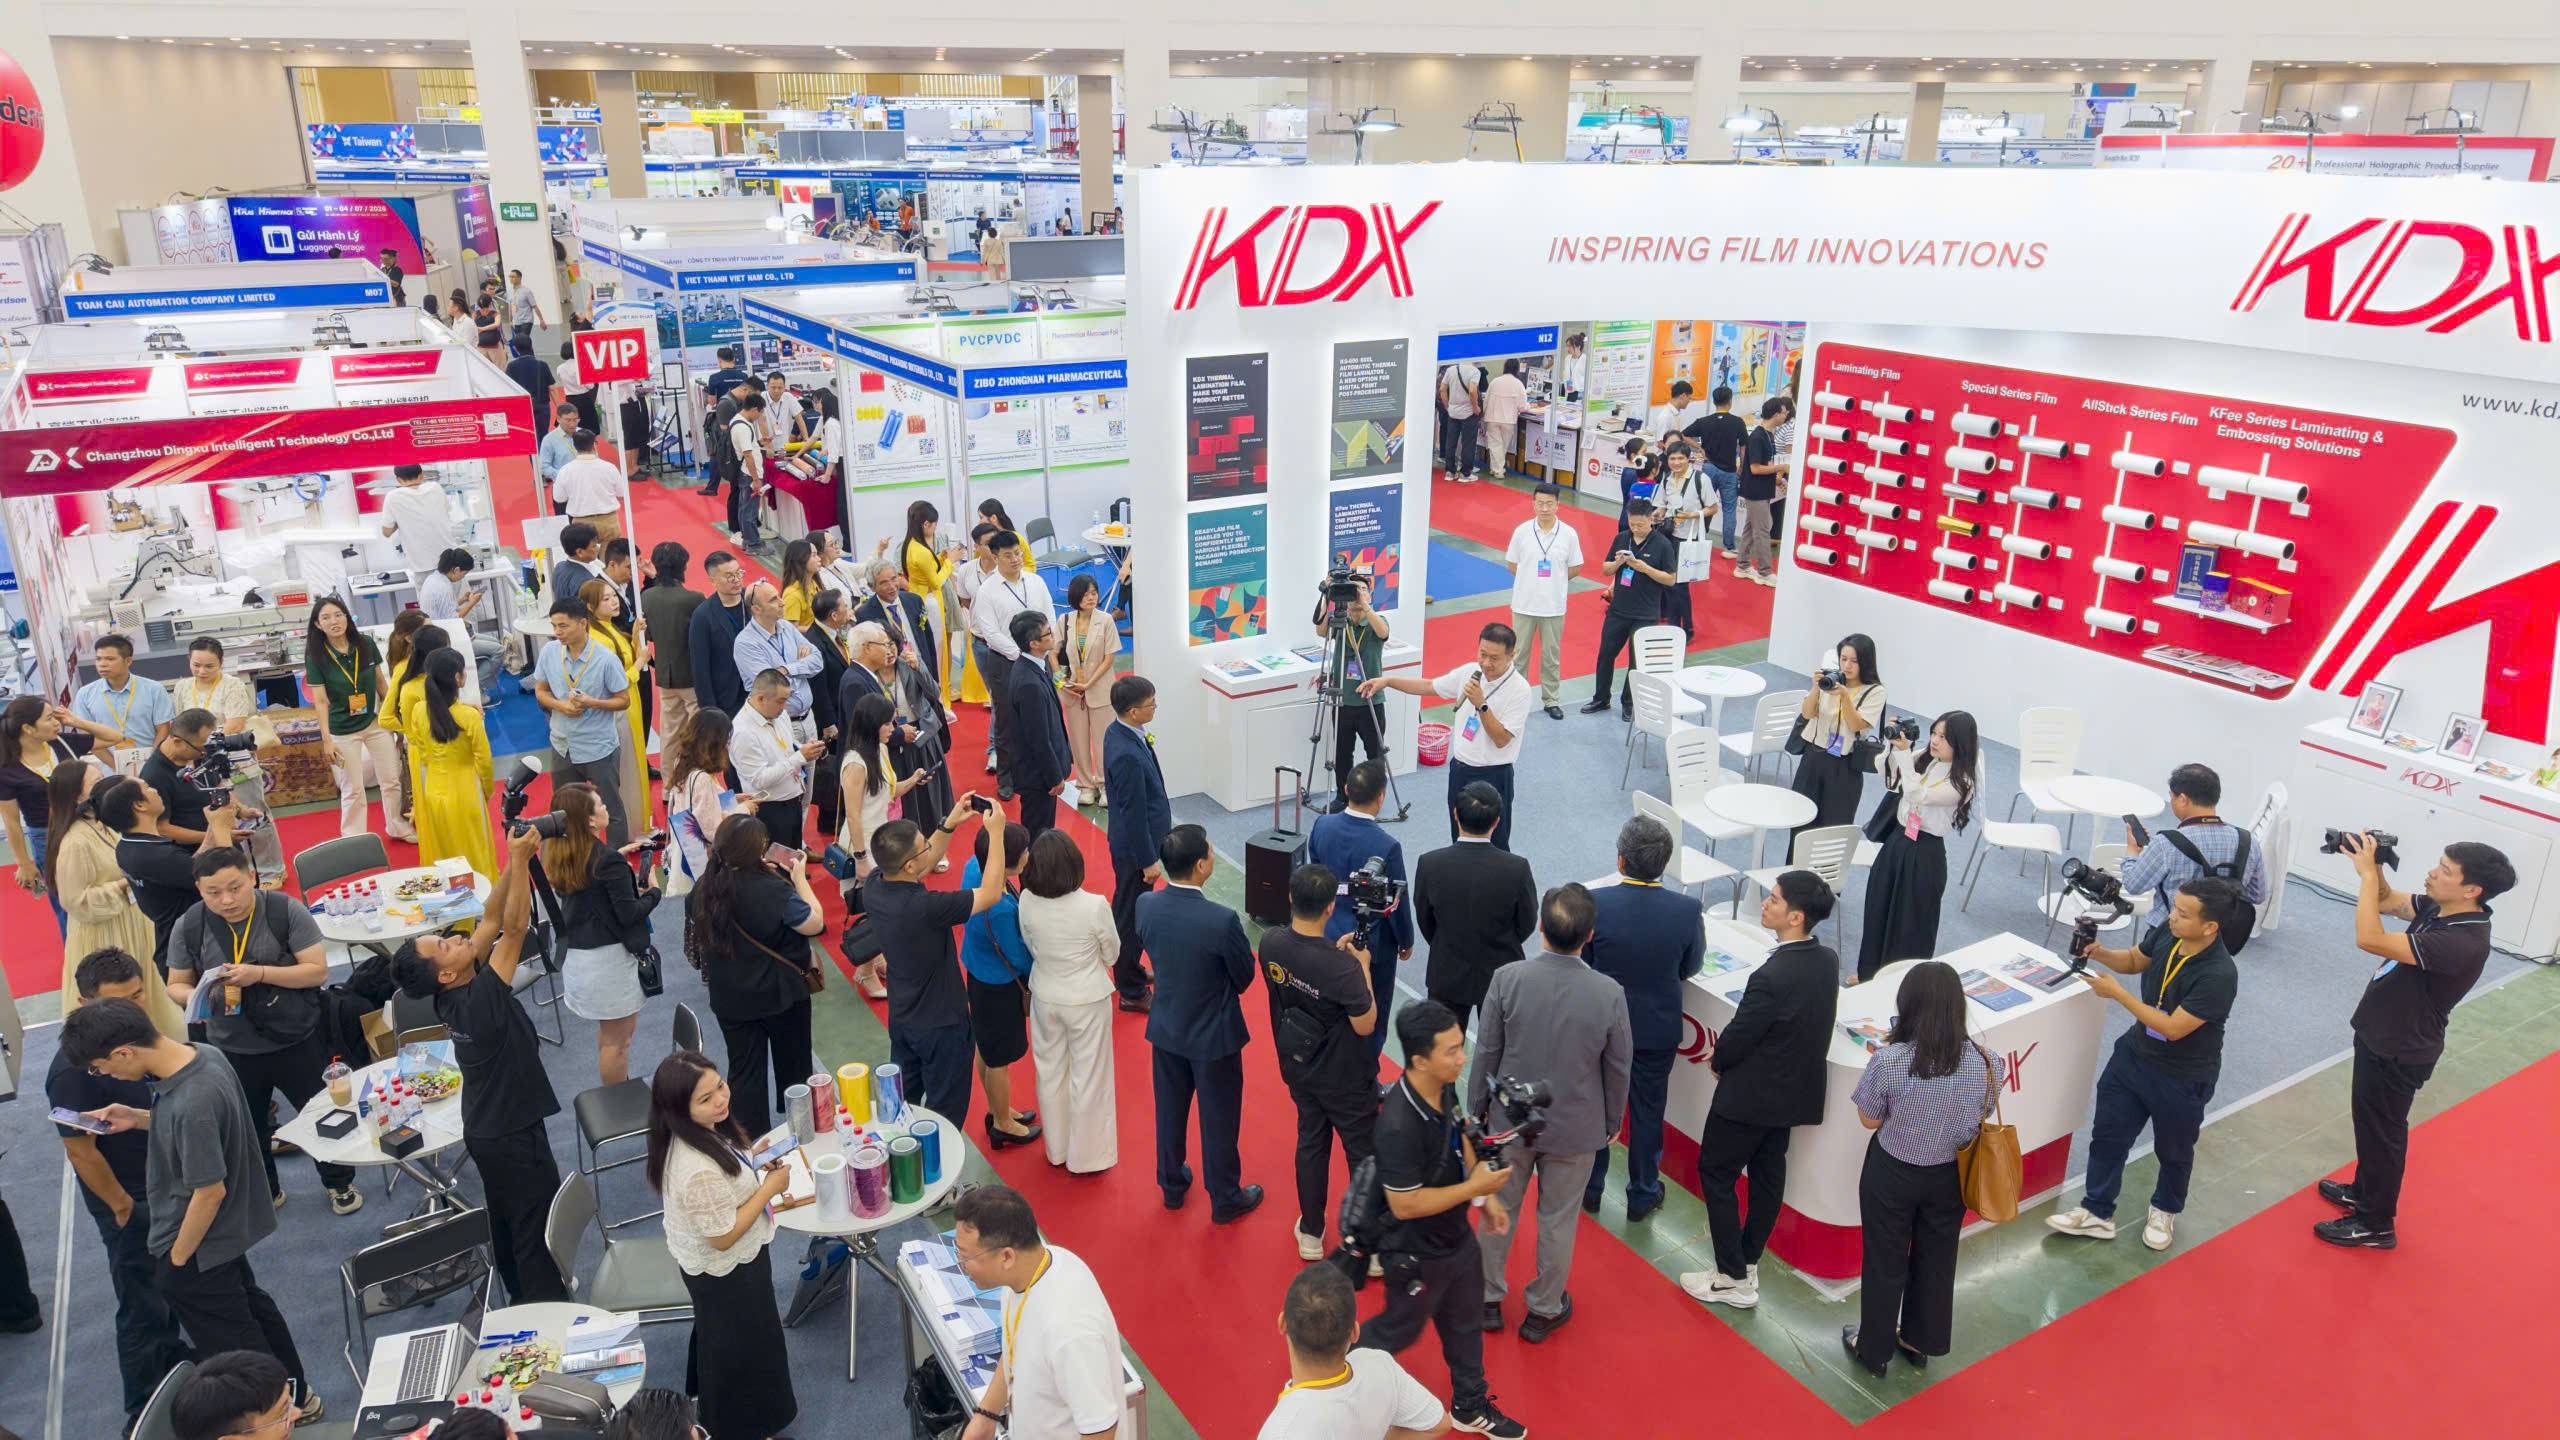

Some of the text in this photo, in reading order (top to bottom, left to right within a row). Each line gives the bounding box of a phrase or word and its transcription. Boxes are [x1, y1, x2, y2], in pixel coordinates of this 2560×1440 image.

[352, 136, 383, 147] Taiwan
[2314, 158, 2366, 169] Professional
[2370, 160, 2421, 171] Holographic
[2463, 162, 2500, 172] Supplier
[318, 230, 346, 241] Hành
[299, 244, 366, 252] Luggage Storage
[1174, 201, 1441, 310] KDX
[1549, 235, 2049, 270] INSPIRING FILM INNOVATIONS
[684, 276, 701, 285] VIET
[703, 275, 728, 284] THANH
[730, 274, 745, 283] VIET
[747, 273, 763, 282] NAM
[780, 272, 794, 281] LTD
[2230, 212, 2560, 343] KDX
[76, 293, 276, 311] TOAN CAU AUTOMATION COMPANY LIMITED
[364, 288, 384, 297] M07
[959, 332, 1022, 347] PVCPVDC
[1538, 333, 1553, 343] N12
[584, 338, 639, 370] VIP
[973, 369, 1123, 389] ZIBO ZHONGNAN PHARMACEUTICAL
[1831, 360, 1901, 381] Laminating Film
[1192, 381, 1230, 390] LAMINATION
[1192, 388, 1228, 397] MAKE YOUR
[1961, 380, 2058, 405] Special Series Film
[1192, 395, 1221, 404] PRODUCT
[2081, 397, 2199, 427] AllStick Series Film
[2209, 406, 2385, 444] KFee Series Laminating &
[86, 447, 161, 463] Changzhou
[163, 444, 209, 458] Dingxu
[211, 437, 275, 452] Intelligent
[276, 431, 350, 447] Technology
[2216, 424, 2362, 458] Embossing Solutions
[2400, 767, 2463, 797] KDX
[1288, 973, 1320, 996] Eventus
